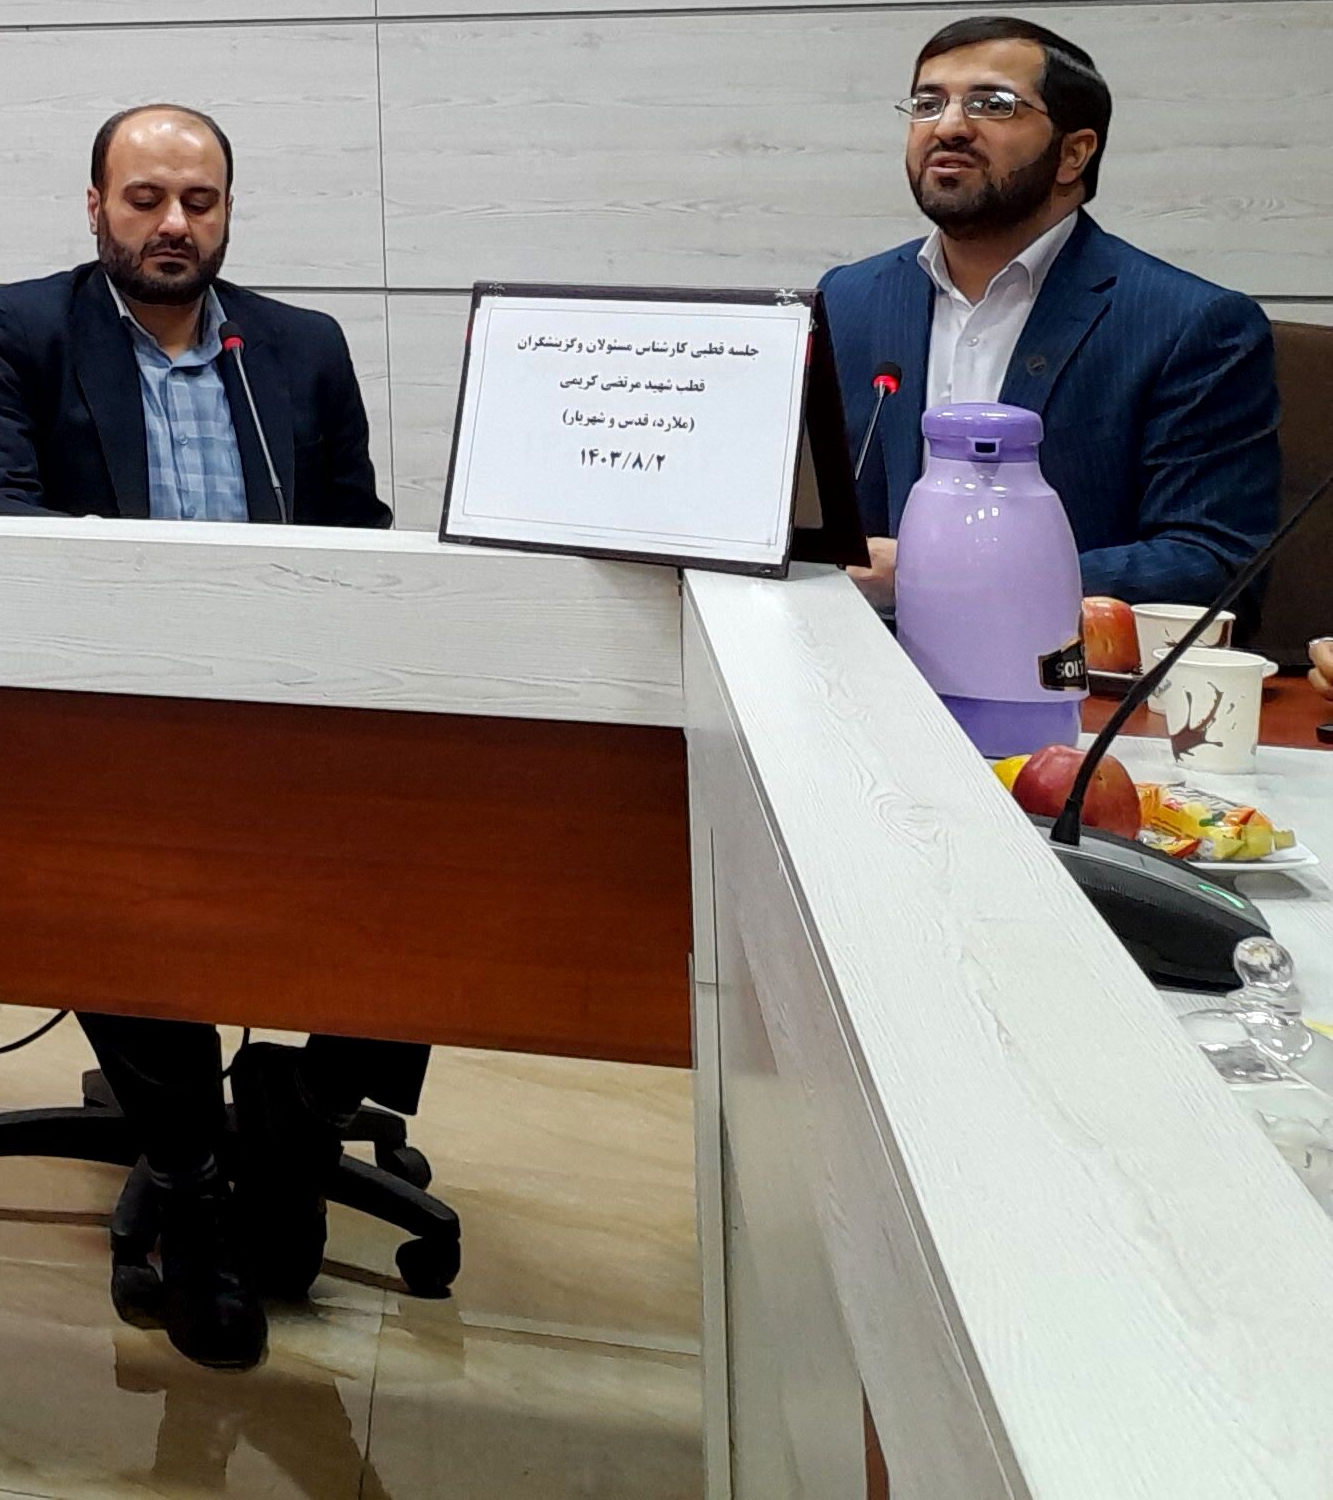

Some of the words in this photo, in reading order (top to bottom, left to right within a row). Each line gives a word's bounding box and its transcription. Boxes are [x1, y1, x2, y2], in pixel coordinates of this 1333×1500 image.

[585, 338, 633, 355] مسئولان
[635, 341, 689, 357] کارشناس
[690, 342, 725, 358] قطبی
[727, 344, 760, 361] جلسه
[559, 374, 599, 390] کریمی
[600, 376, 642, 393] مرتضی
[644, 378, 673, 393] شهید
[675, 378, 706, 395] قطب
[607, 417, 615, 429] و
[617, 413, 649, 429] قدس
[580, 447, 666, 472] ۱۴۰۳/۸/۲
